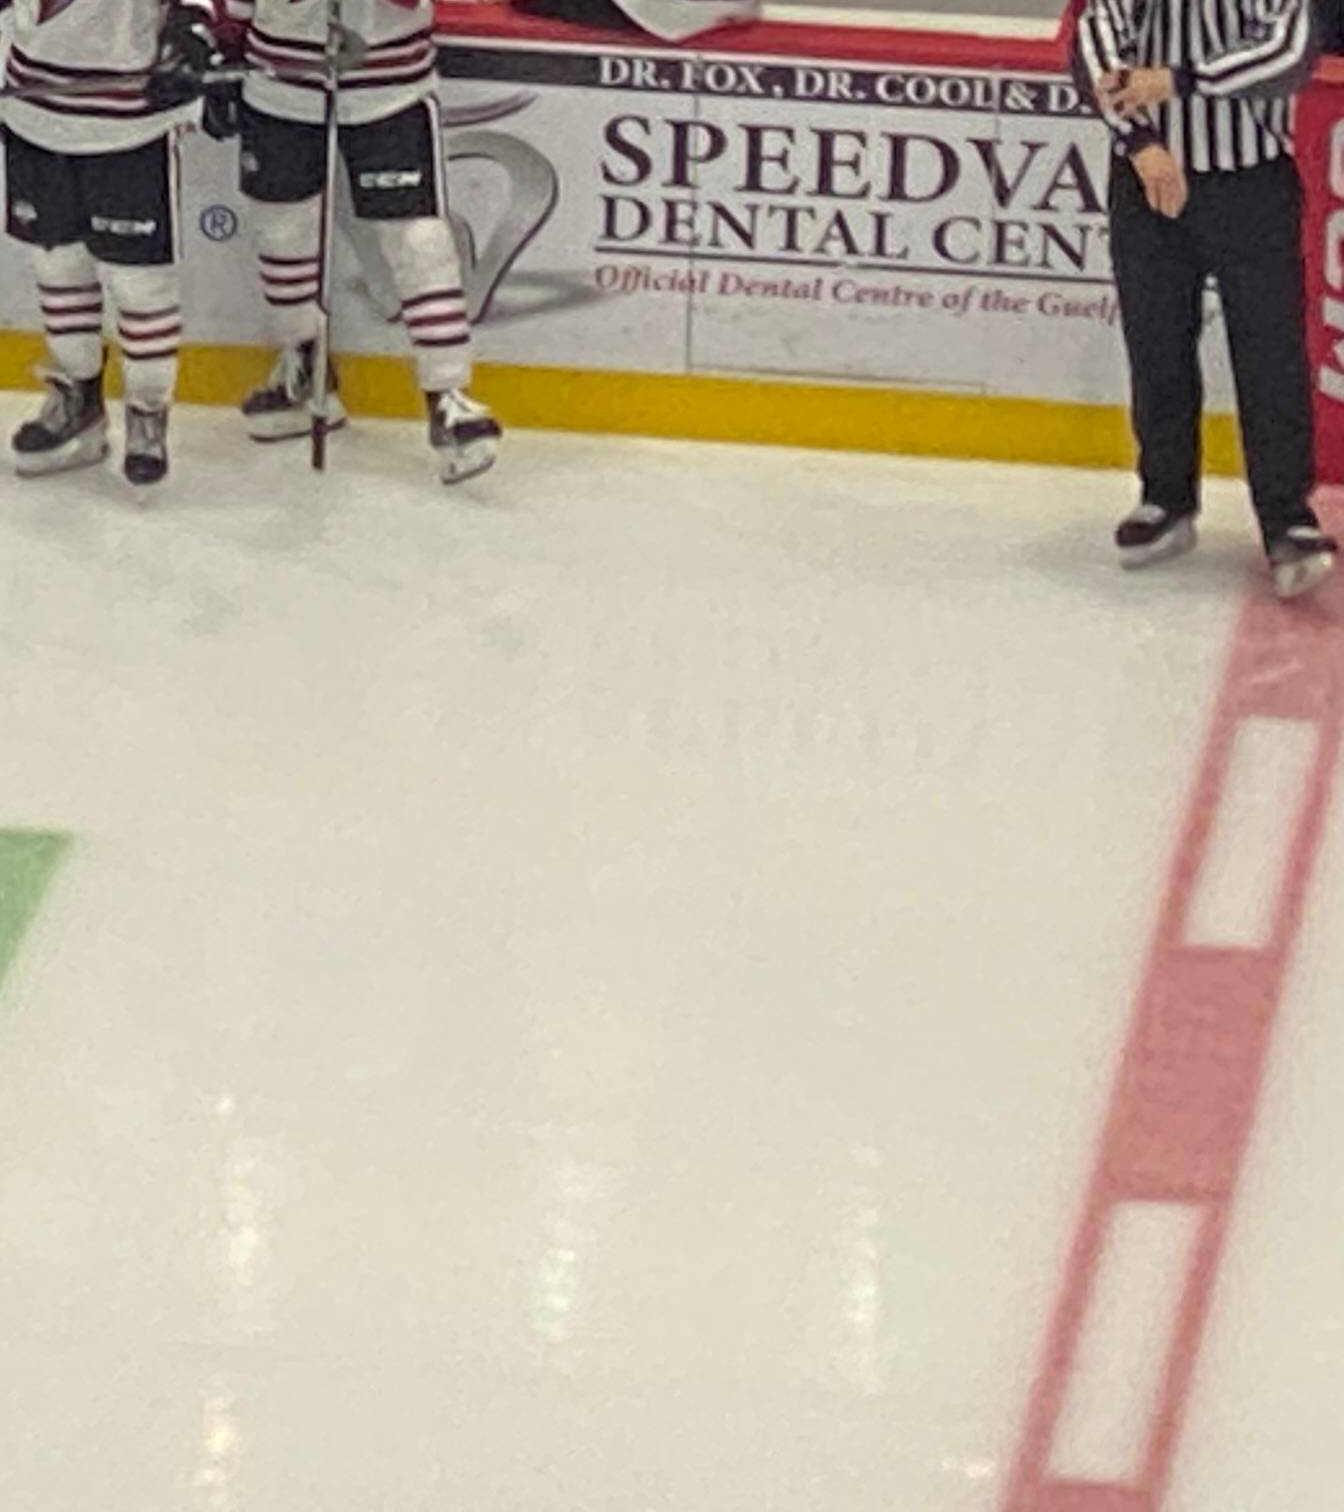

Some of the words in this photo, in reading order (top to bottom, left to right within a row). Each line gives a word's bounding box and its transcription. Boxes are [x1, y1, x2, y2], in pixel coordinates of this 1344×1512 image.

[599, 55, 670, 88] DR.
[794, 67, 867, 100] DR.
[1005, 82, 1038, 111] &
[600, 114, 1111, 216] SPEEDVA
[600, 194, 910, 260] DENTAL
[932, 216, 1111, 273] CEN
[595, 263, 711, 295] Official
[718, 272, 825, 301] Dental
[832, 278, 934, 307] Centre
[941, 285, 978, 318] of
[980, 289, 1030, 314] the
